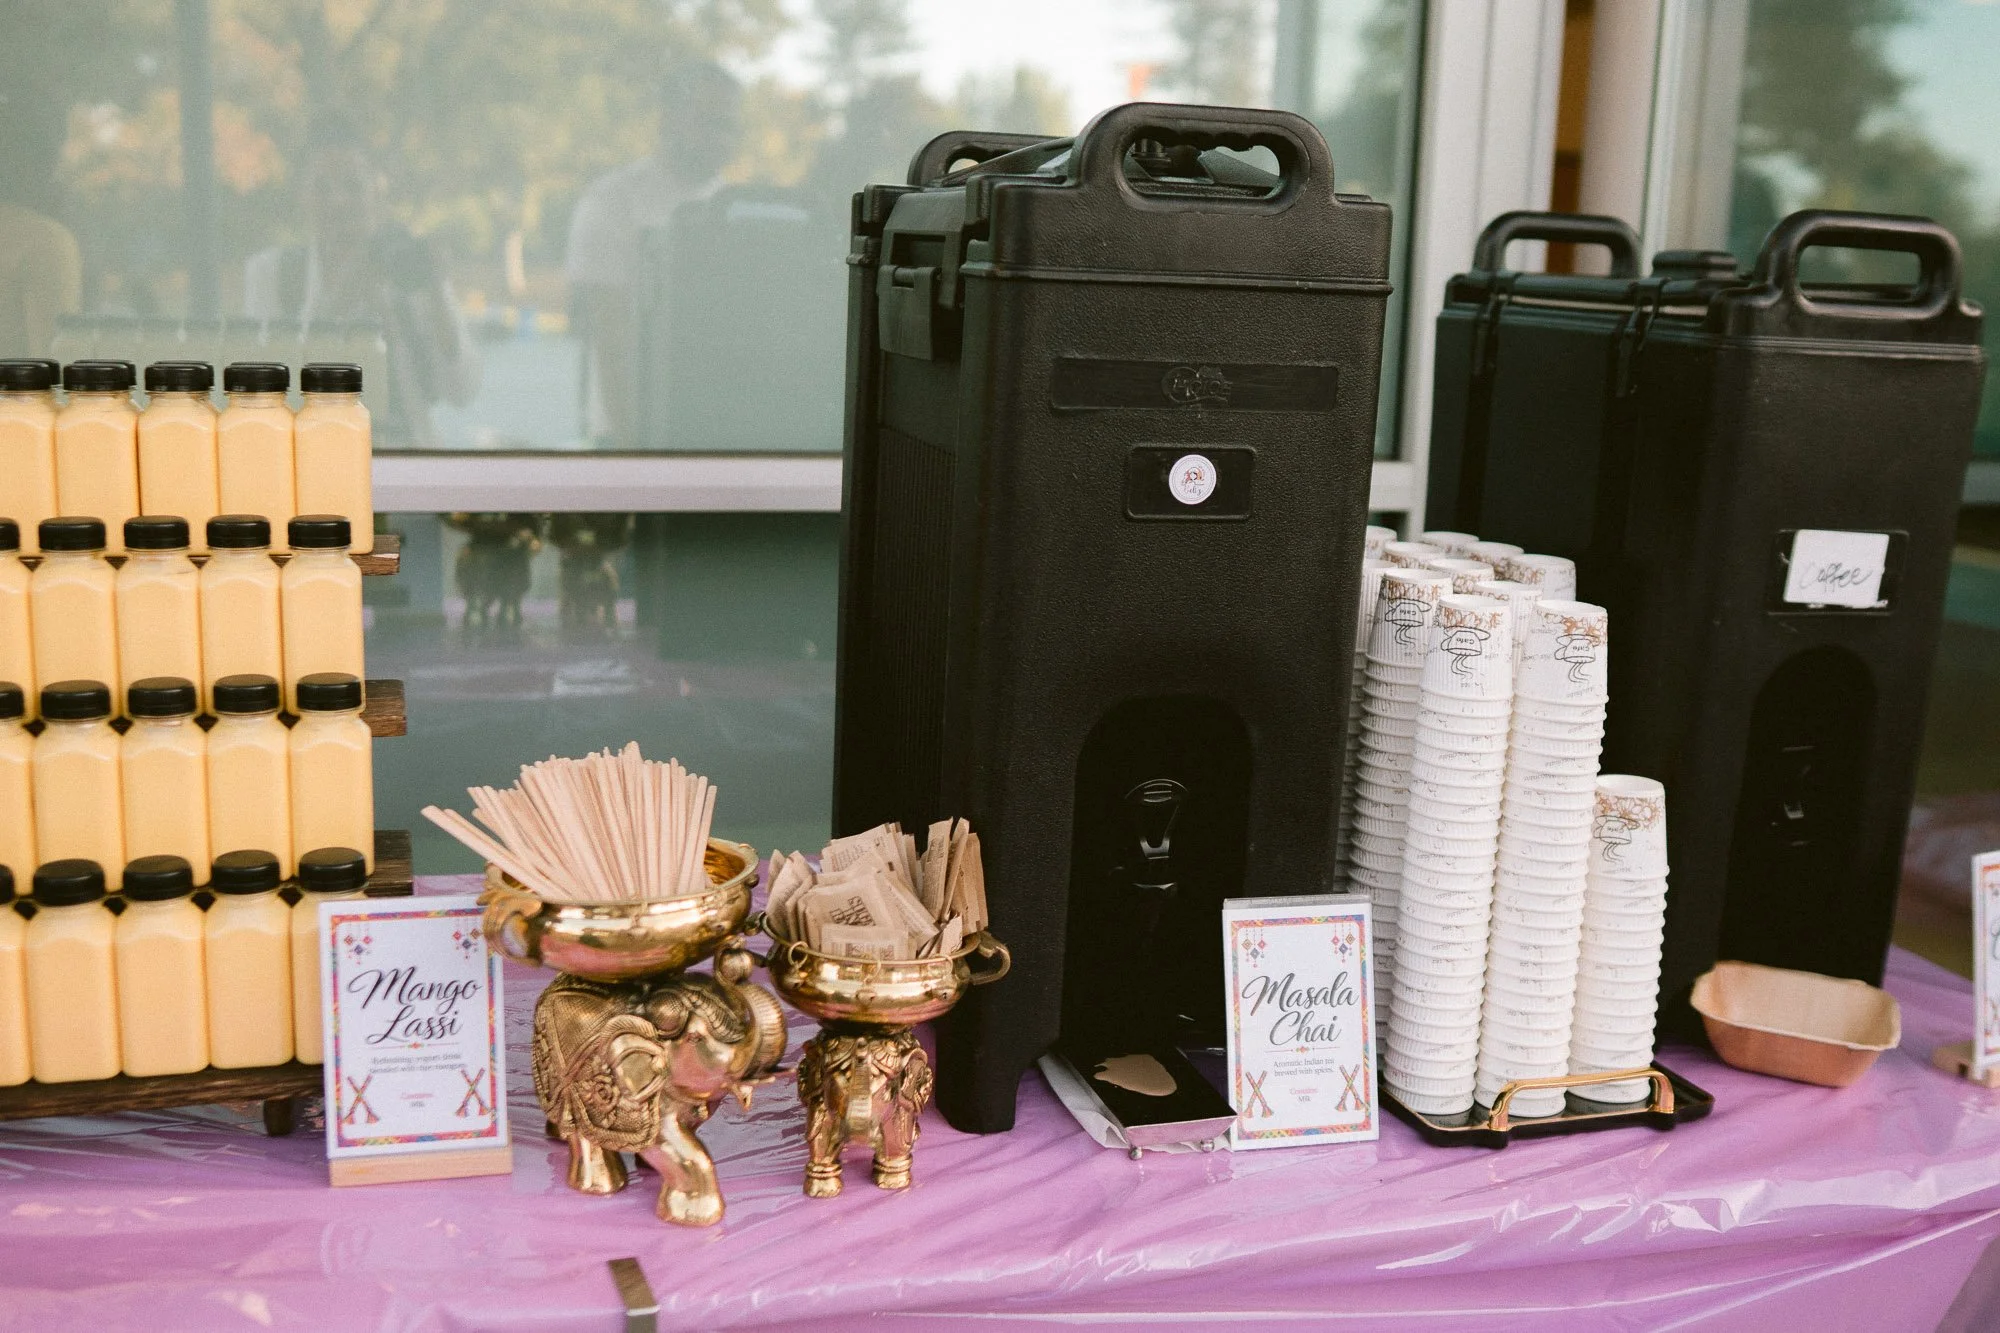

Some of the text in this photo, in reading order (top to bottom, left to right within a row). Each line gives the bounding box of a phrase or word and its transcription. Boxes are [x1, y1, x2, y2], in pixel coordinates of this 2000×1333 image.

[347, 966, 483, 1015] Mango
[1241, 971, 1359, 1016] Masala
[365, 1005, 464, 1045] Lassi
[1269, 1010, 1342, 1046] Chai
[1274, 1067, 1297, 1077] brewed
[1298, 1067, 1313, 1075] with
[1304, 1058, 1324, 1066] Indian
